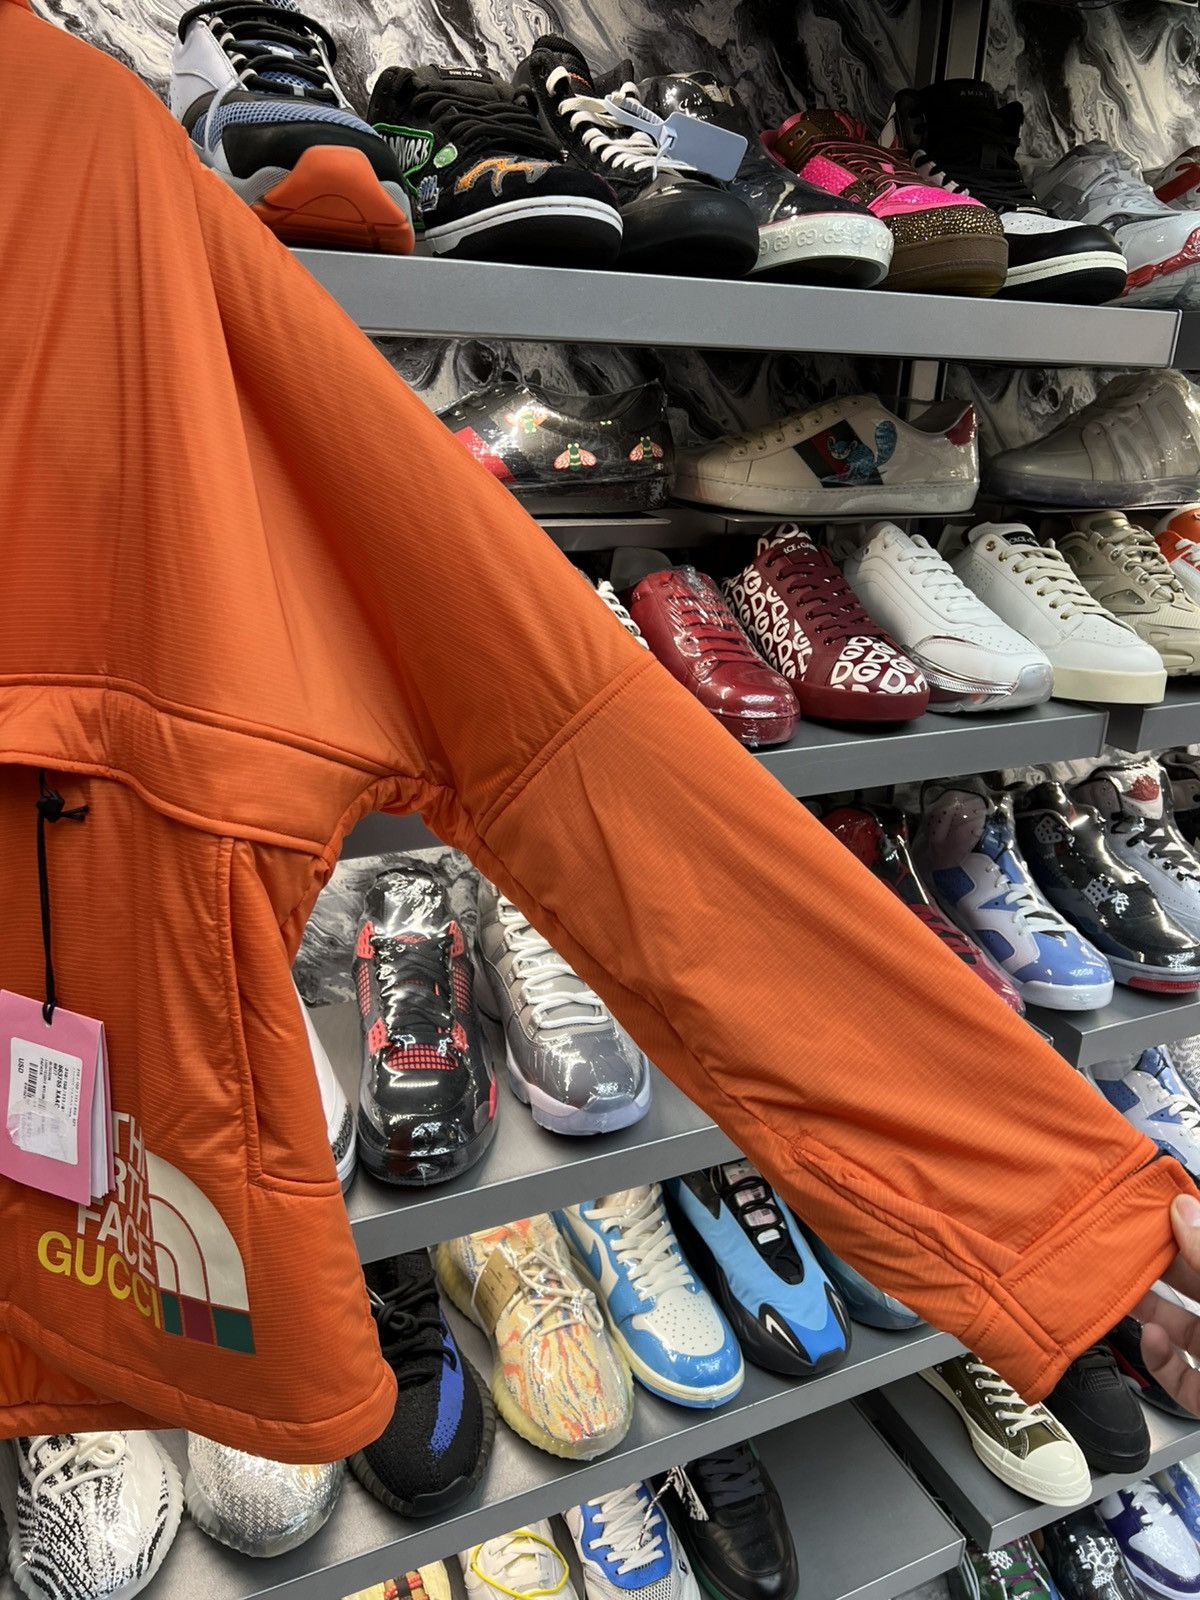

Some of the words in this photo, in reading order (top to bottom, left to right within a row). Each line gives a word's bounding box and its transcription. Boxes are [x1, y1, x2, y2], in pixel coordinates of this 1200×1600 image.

[112, 1110, 146, 1180] TH
[37, 1230, 162, 1330] GUCCI
[77, 1196, 156, 1286] FACE
